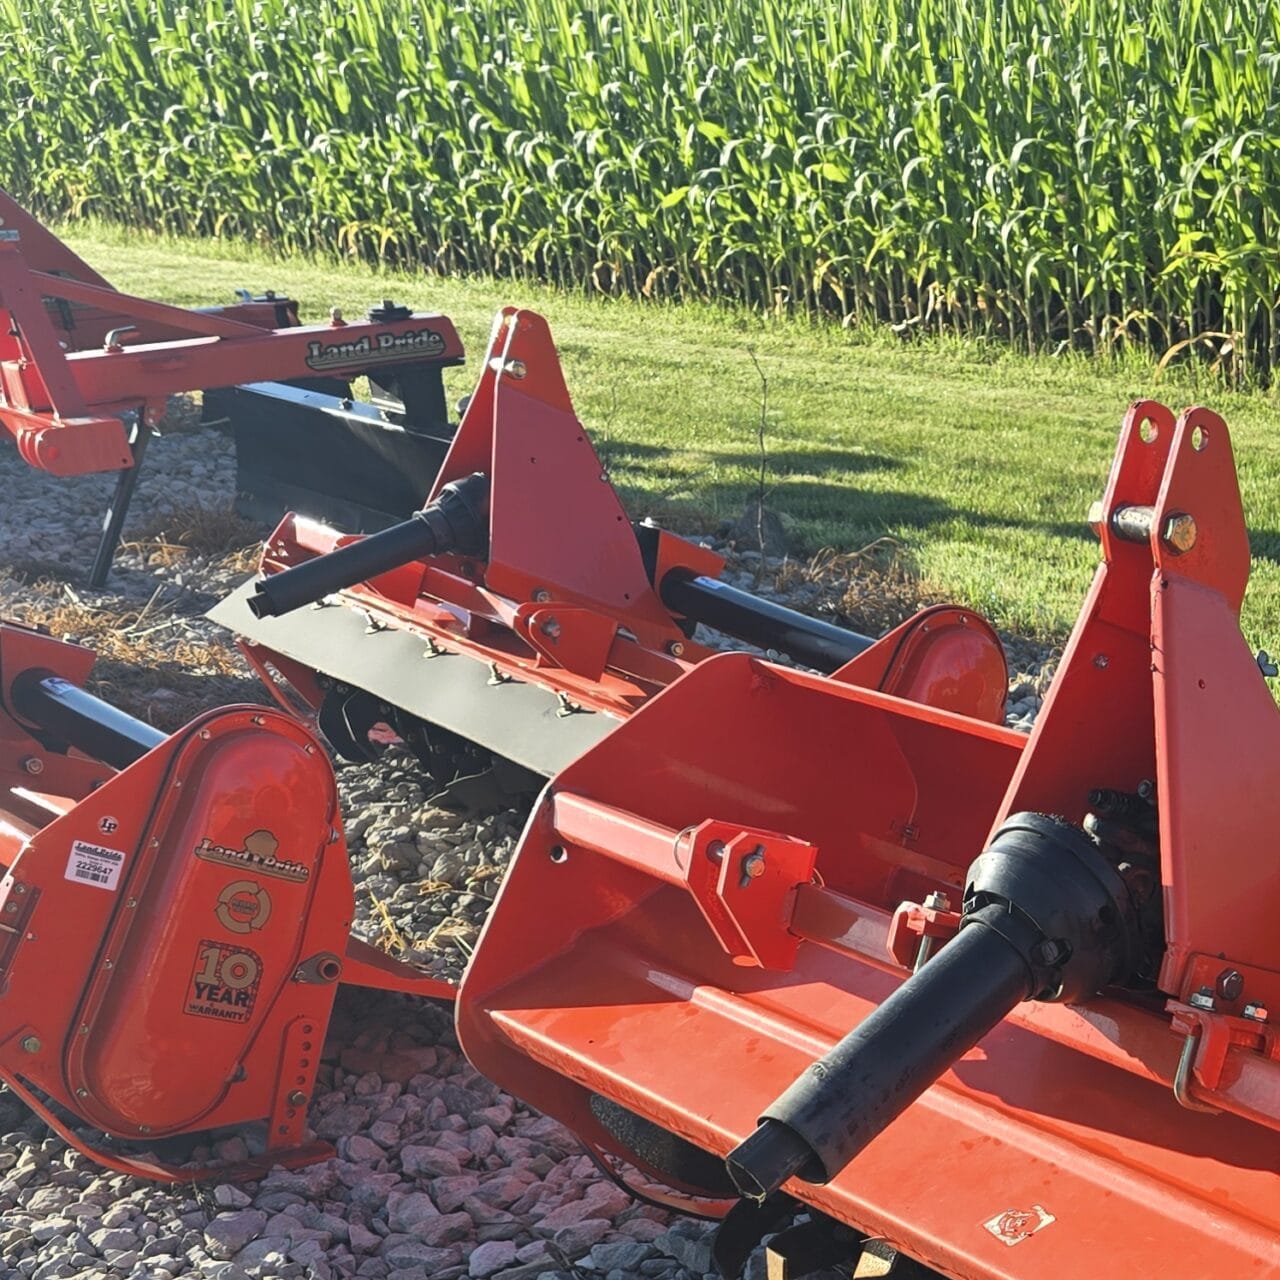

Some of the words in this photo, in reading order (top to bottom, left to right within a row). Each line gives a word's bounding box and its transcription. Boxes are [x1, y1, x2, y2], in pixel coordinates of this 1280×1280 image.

[309, 337, 371, 362] Land
[378, 330, 442, 353] Pride
[200, 838, 250, 865] Land
[264, 855, 309, 877] Pride
[195, 948, 257, 989] 10
[194, 981, 251, 1008] YEAR
[188, 1003, 244, 1021] WARRANTY
